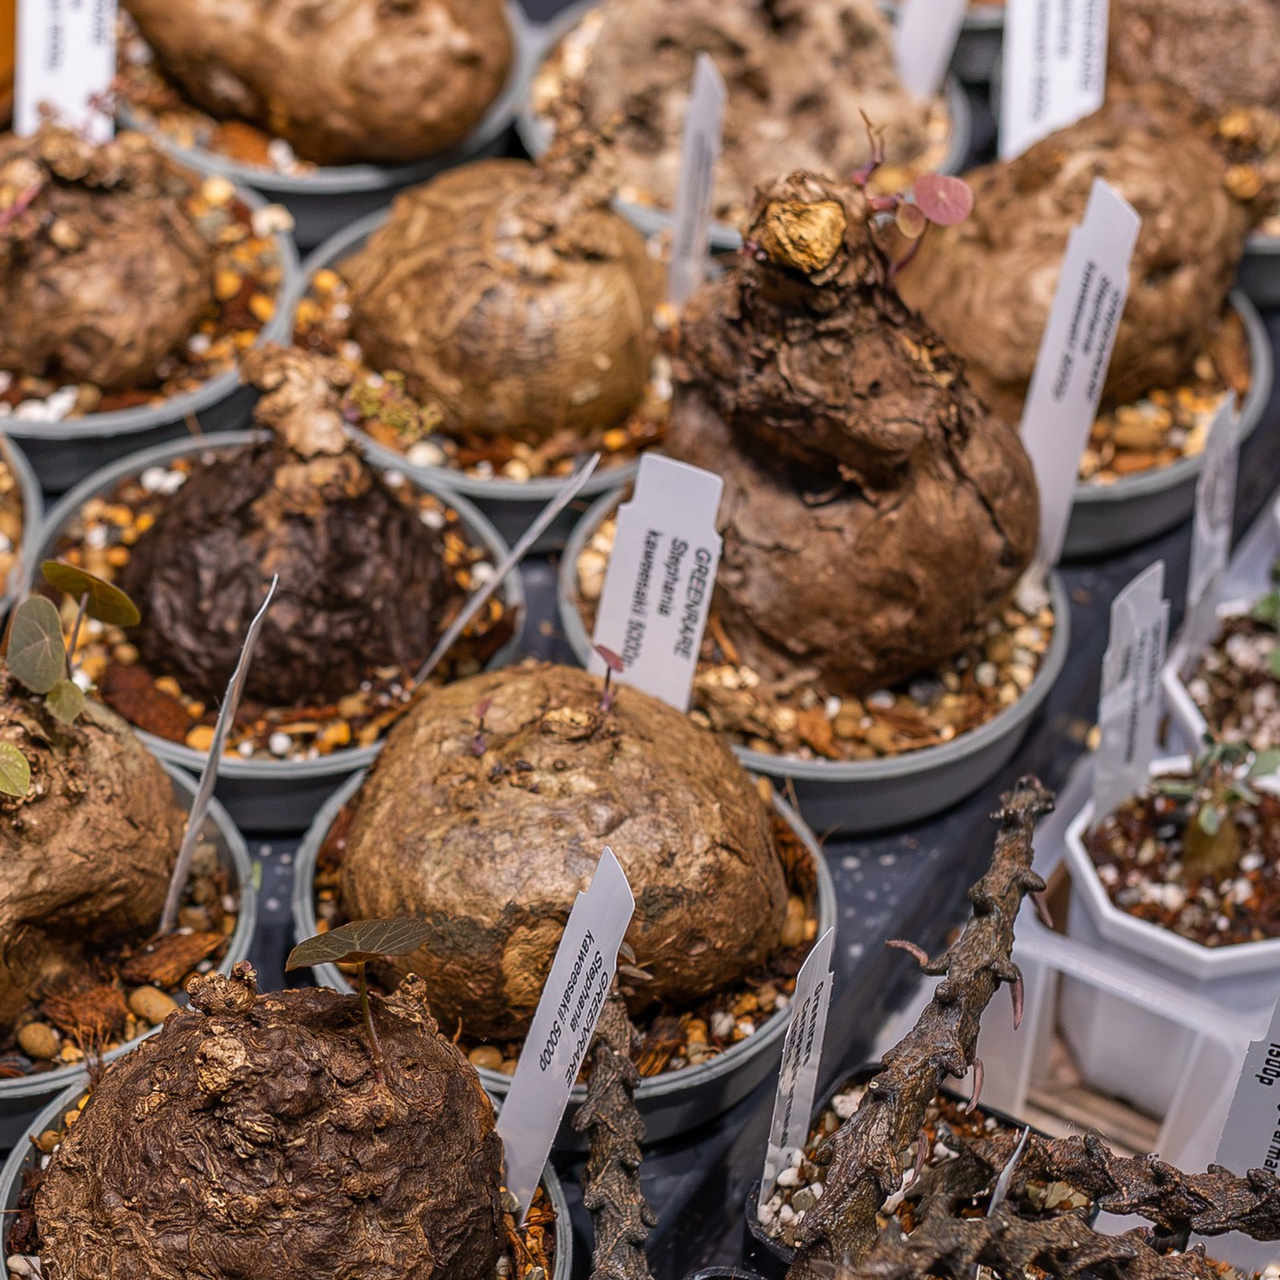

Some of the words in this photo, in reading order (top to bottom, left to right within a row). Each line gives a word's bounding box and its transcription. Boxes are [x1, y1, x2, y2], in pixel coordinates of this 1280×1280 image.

[674, 547, 711, 660] GREENRARE
[556, 929, 595, 1024] kaweesakii
[569, 949, 603, 1033] Stephania
[539, 1020, 562, 1072] 5000p
[565, 970, 609, 1090] GREENRARE
